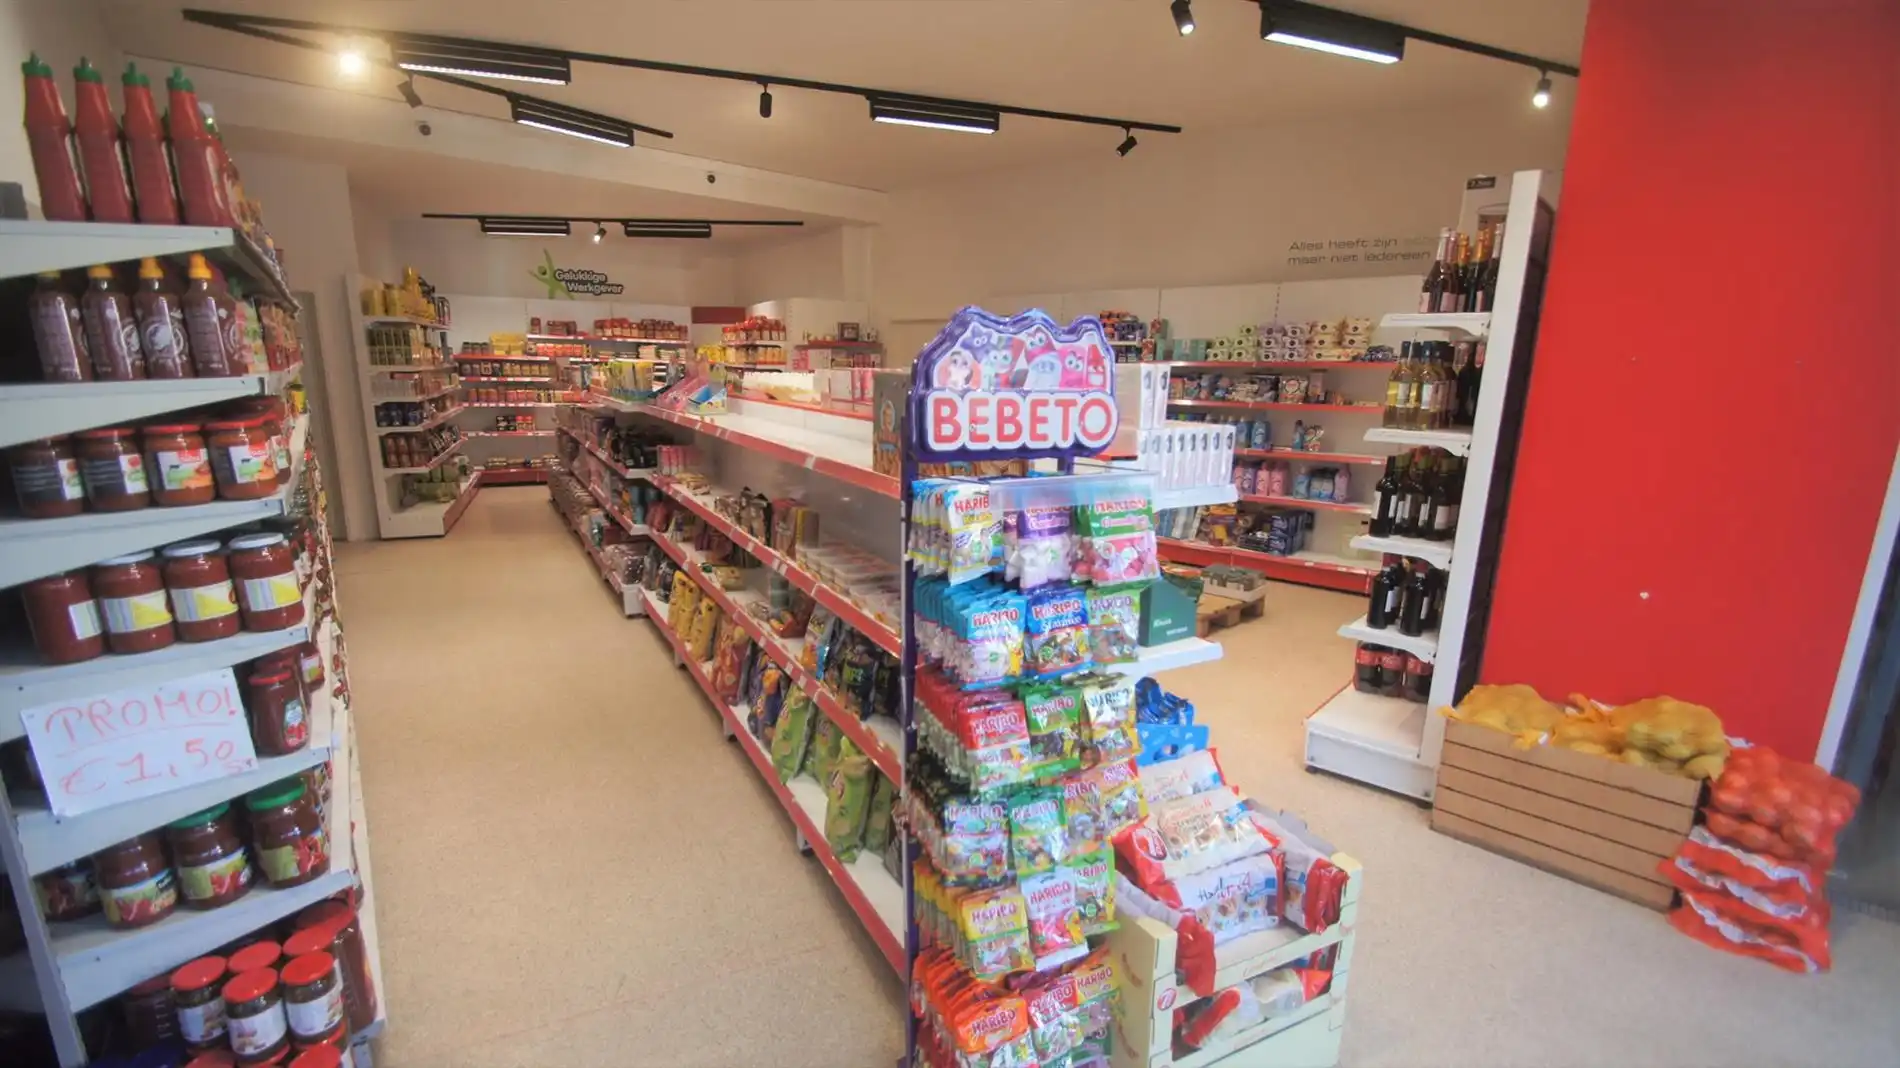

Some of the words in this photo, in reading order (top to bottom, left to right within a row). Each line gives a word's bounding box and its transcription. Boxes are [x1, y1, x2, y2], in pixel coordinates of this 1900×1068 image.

[1288, 240, 1323, 251] Alles
[1328, 238, 1368, 249] heeft
[1373, 237, 1397, 249] zijn
[1288, 254, 1325, 265] maar
[1330, 252, 1358, 263] niet
[1364, 250, 1431, 262] iedereen
[554, 269, 607, 284] Gelukkige
[566, 280, 623, 296] Werkgever
[932, 397, 1113, 444] BEBETO
[45, 687, 237, 744] PROMO!
[971, 1008, 1017, 1035] HARIBO
